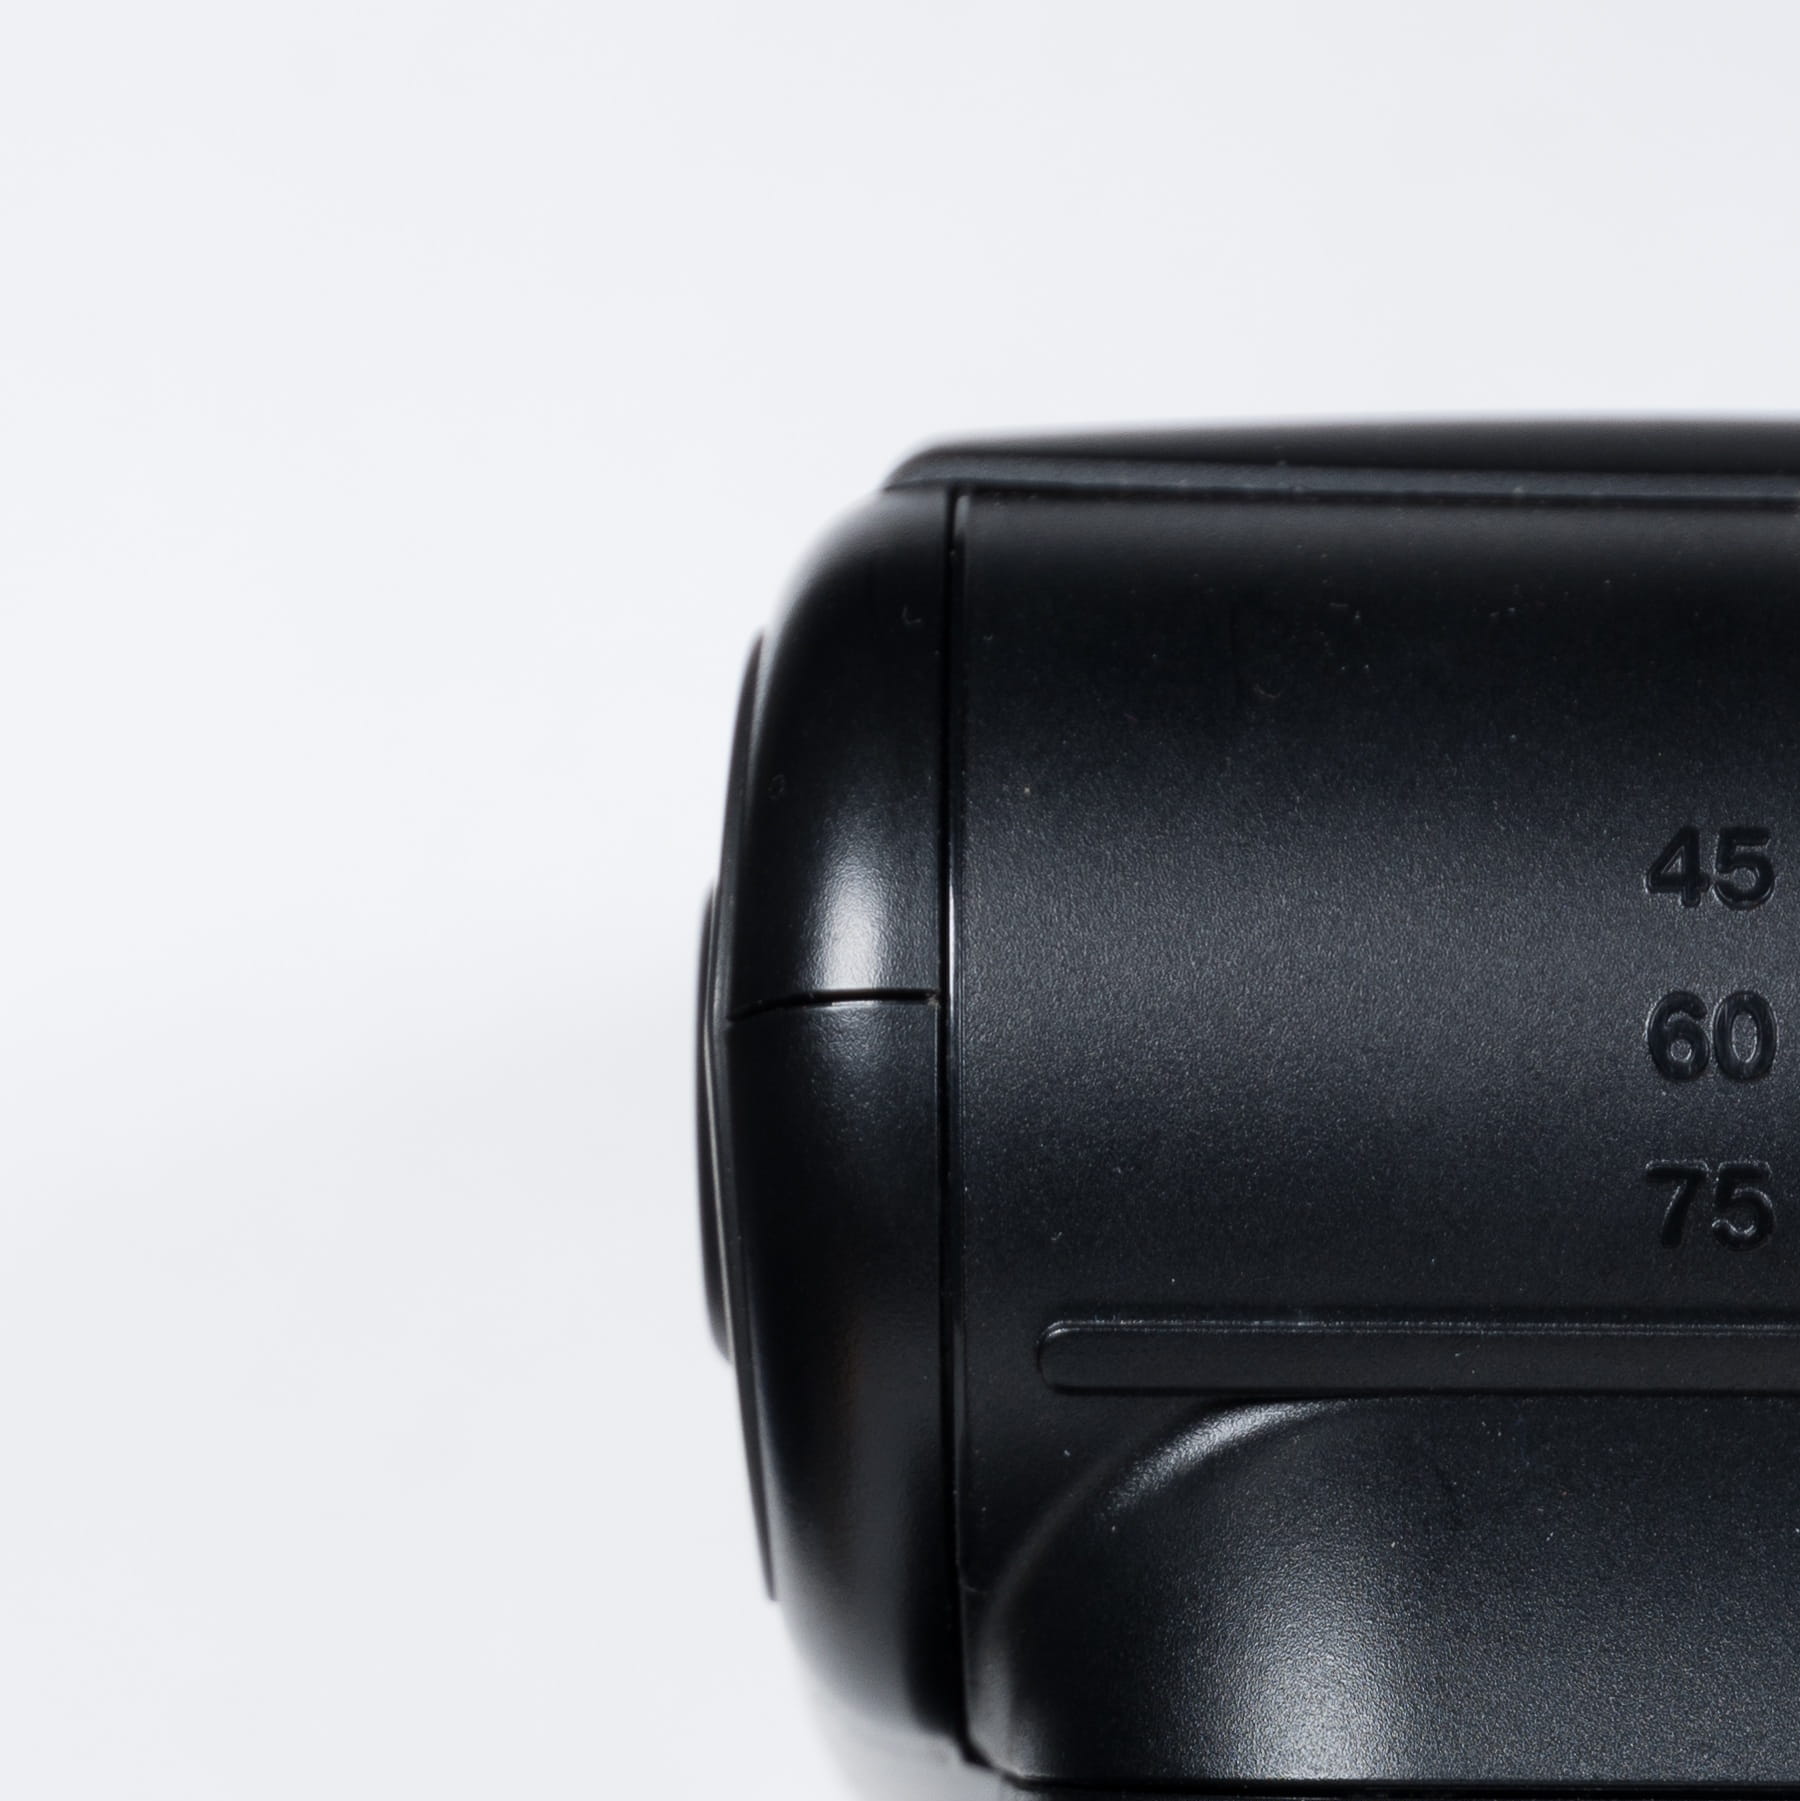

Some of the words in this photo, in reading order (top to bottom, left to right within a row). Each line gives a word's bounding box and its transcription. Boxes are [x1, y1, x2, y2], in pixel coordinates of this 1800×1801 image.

[1644, 825, 1777, 911] 45
[1645, 989, 1779, 1083] 60
[1645, 1159, 1776, 1252] 75
